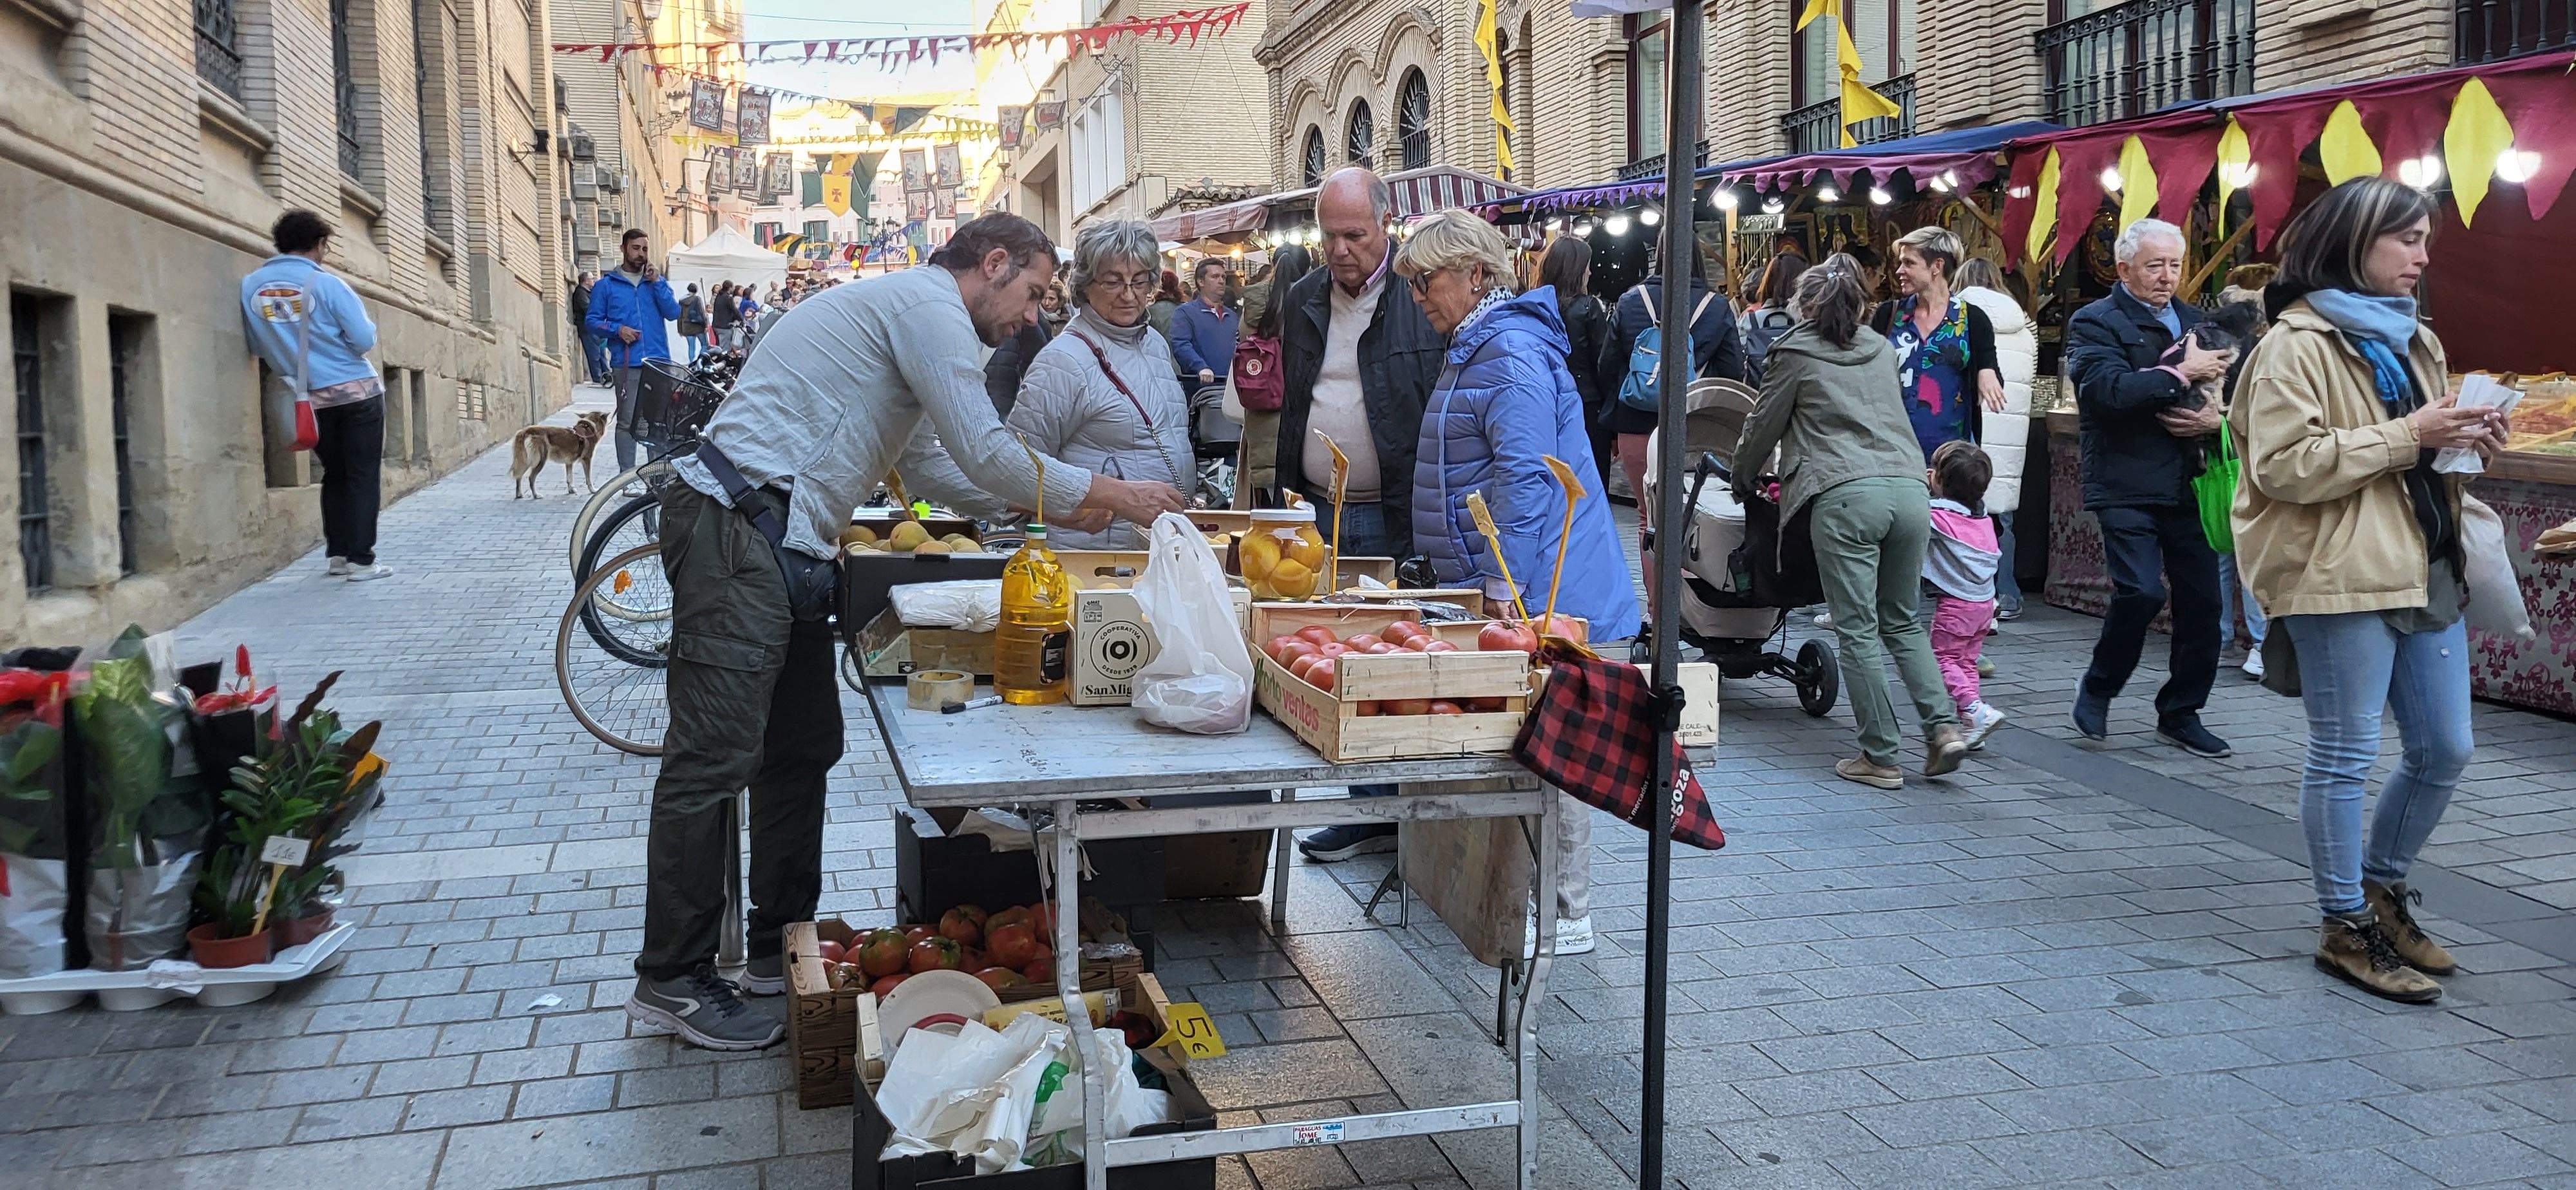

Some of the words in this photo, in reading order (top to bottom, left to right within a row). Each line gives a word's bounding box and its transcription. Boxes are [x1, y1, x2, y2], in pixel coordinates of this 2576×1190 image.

[1100, 625, 1142, 640] COOPERATIVA
[1102, 665, 1122, 675] DESDE
[1631, 780, 1649, 817] mercados
